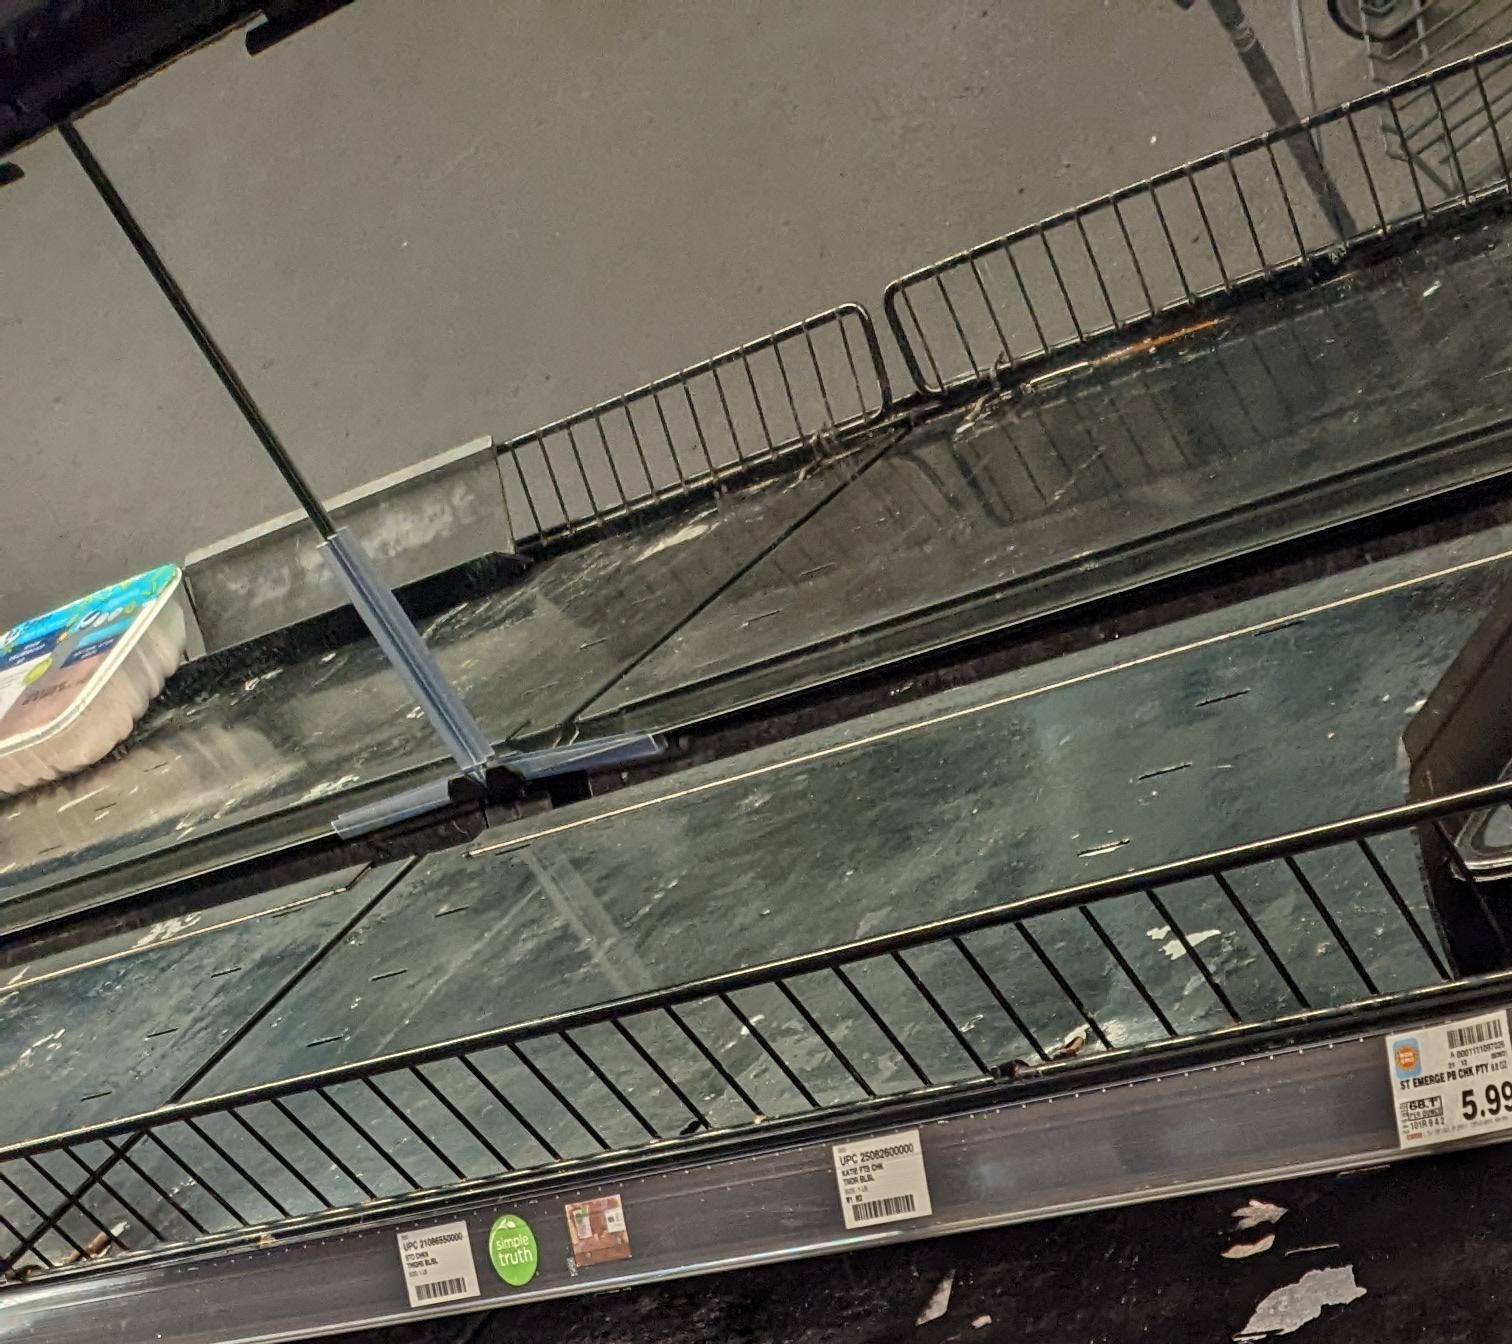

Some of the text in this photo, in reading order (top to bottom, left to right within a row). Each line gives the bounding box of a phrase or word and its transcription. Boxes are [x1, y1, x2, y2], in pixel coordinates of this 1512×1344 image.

[1400, 1063, 1488, 1090] ST EMERGE PB CHK PTY
[496, 1235, 529, 1250] simple
[498, 1248, 533, 1266] truth
